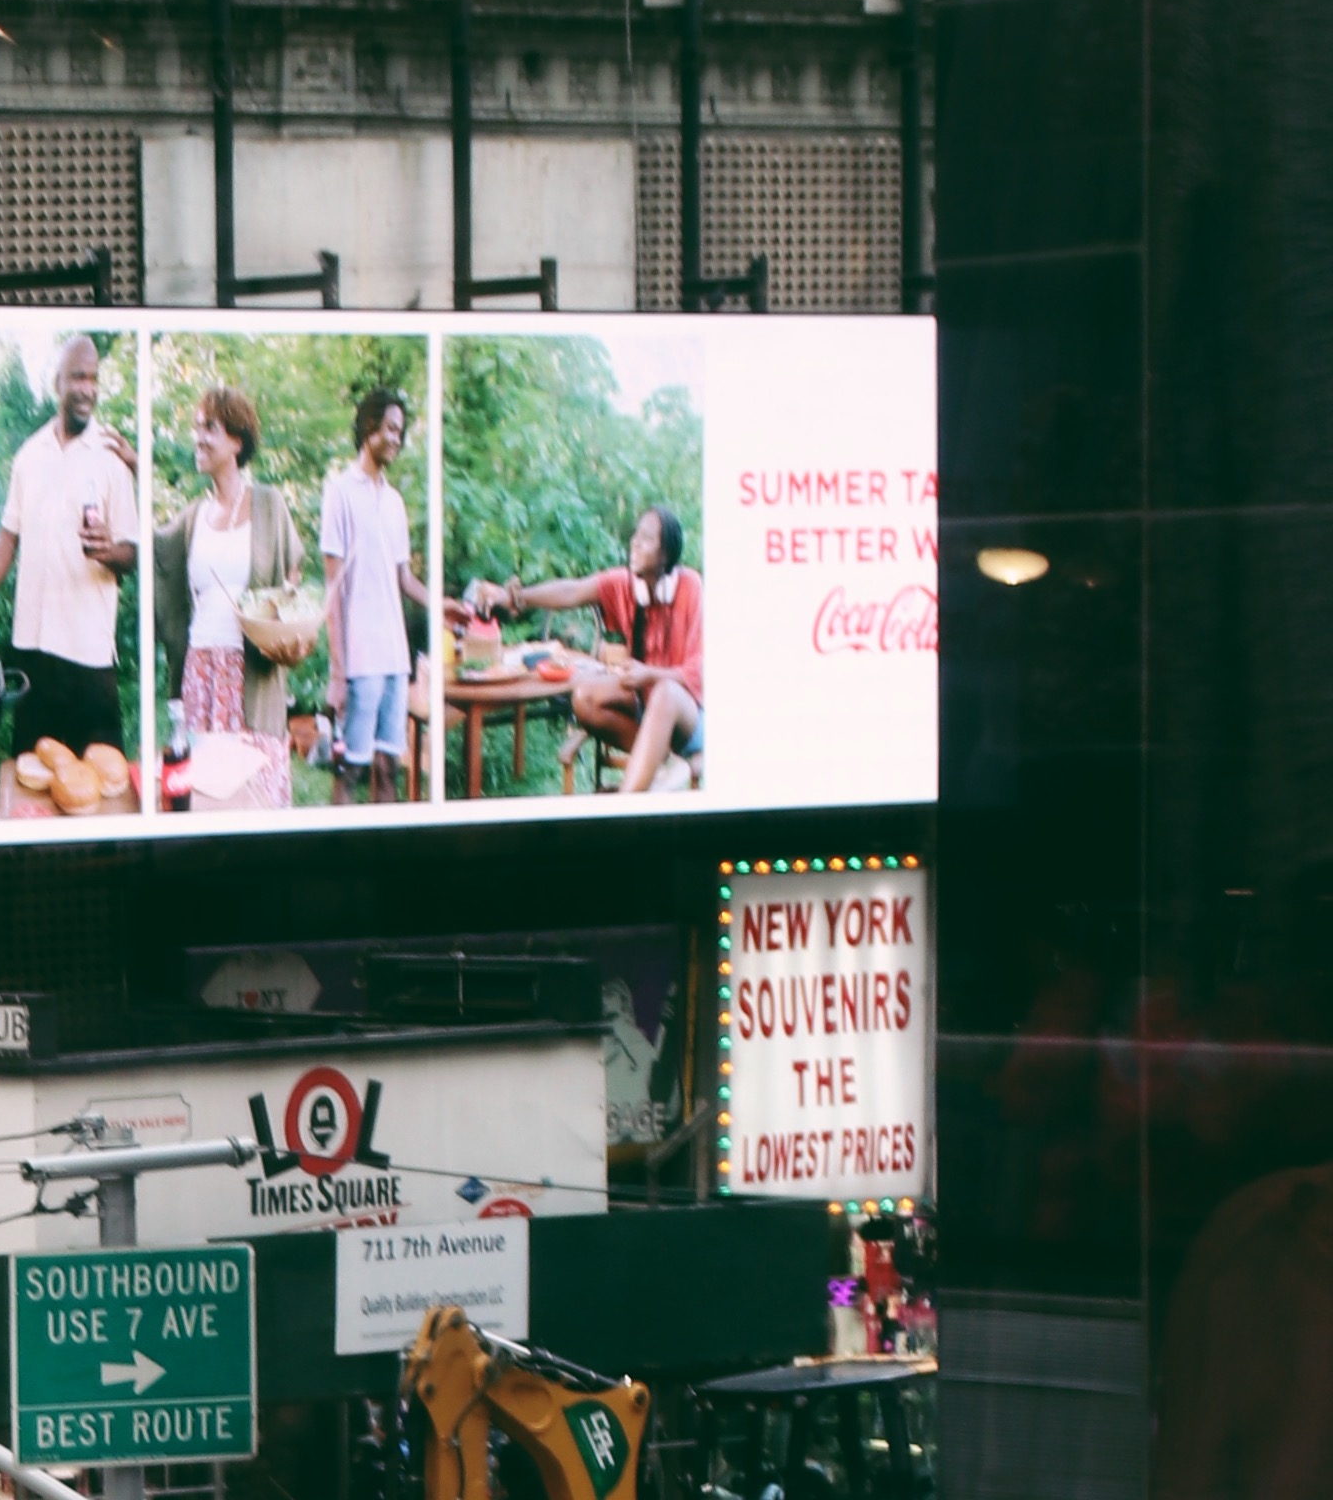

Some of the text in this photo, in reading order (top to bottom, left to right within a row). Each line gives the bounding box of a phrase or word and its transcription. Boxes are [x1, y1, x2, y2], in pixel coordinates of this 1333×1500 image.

[739, 470, 888, 506] SUMMER
[765, 527, 899, 564] BETTER
[742, 896, 913, 953] NEW YORK
[737, 969, 912, 1041] SOUVENIRS
[791, 1057, 858, 1108] THE
[742, 1122, 916, 1184] LOWEST PRICES
[247, 1173, 402, 1217] TIMES SQUARE
[361, 1231, 507, 1263] 711 7th Avenue
[25, 1260, 240, 1301] SOUTHBOUND
[46, 1303, 219, 1345] USE 7 AVE
[35, 1405, 233, 1449] BEST ROUTE
